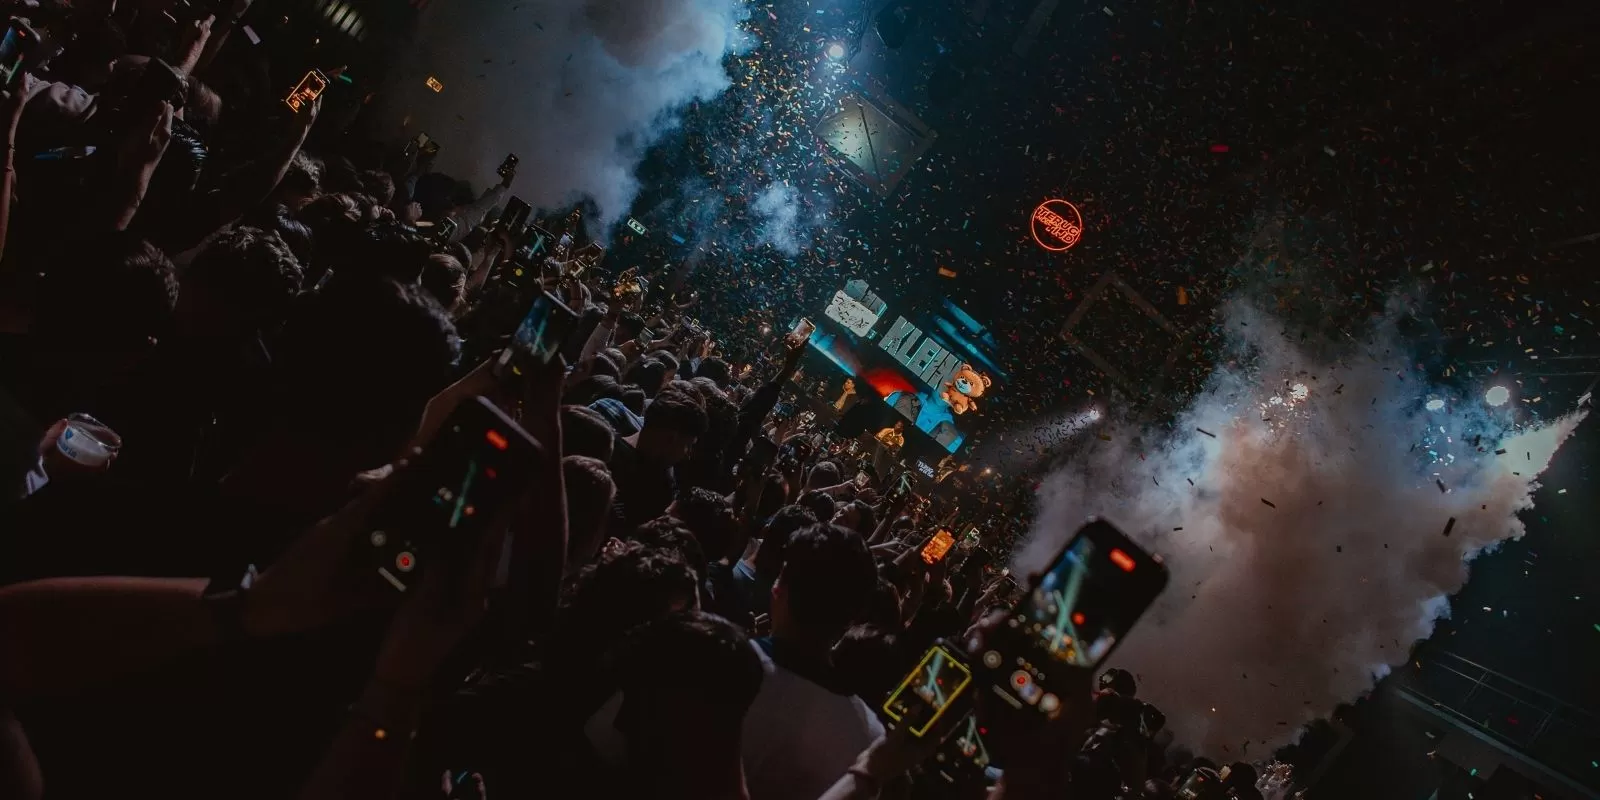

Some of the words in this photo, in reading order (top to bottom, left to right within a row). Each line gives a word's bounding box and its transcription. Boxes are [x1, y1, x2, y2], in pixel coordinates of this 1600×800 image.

[1037, 206, 1079, 236] TERUG
[1046, 222, 1074, 244] TIJD
[878, 315, 963, 392] KLEIN
